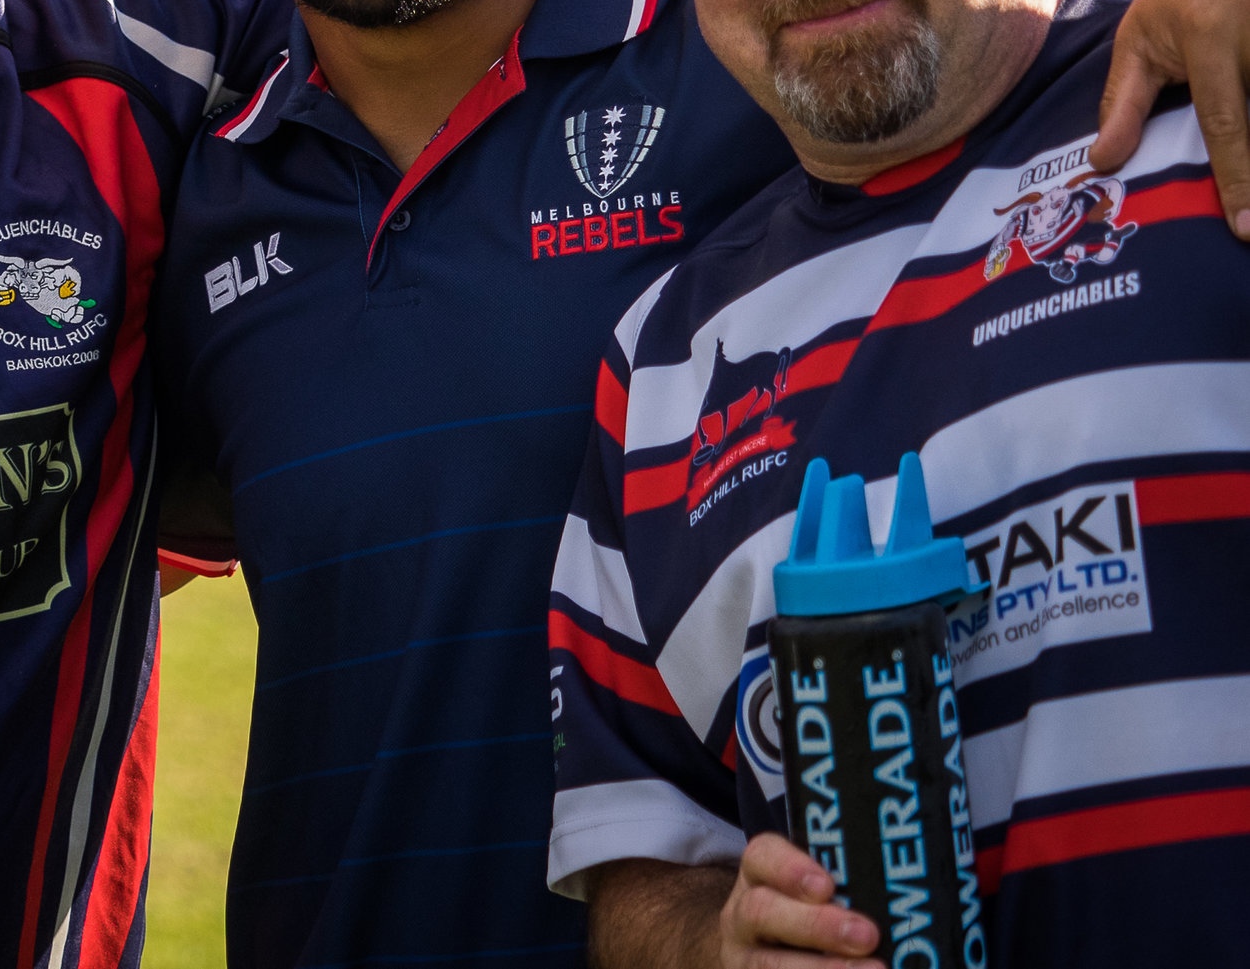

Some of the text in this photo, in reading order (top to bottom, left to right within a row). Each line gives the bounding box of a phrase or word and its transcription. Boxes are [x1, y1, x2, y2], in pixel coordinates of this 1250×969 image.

[1018, 156, 1064, 192] BOX
[531, 191, 681, 225] MELBOURNE
[531, 205, 685, 260] REBELS
[204, 232, 294, 314] BLK
[30, 336, 66, 352] HILL
[65, 313, 108, 347] RUFC
[973, 271, 1140, 347] UNQUENCHABLES
[6, 354, 73, 371] BANGKOK
[690, 495, 712, 527] BOX
[713, 475, 739, 504] HILL
[742, 451, 788, 482] RUFC
[965, 493, 1136, 600] TAKI
[949, 559, 1139, 644] NS PTY LTD.
[1004, 613, 1040, 642] and
[791, 670, 850, 910] ERADE
